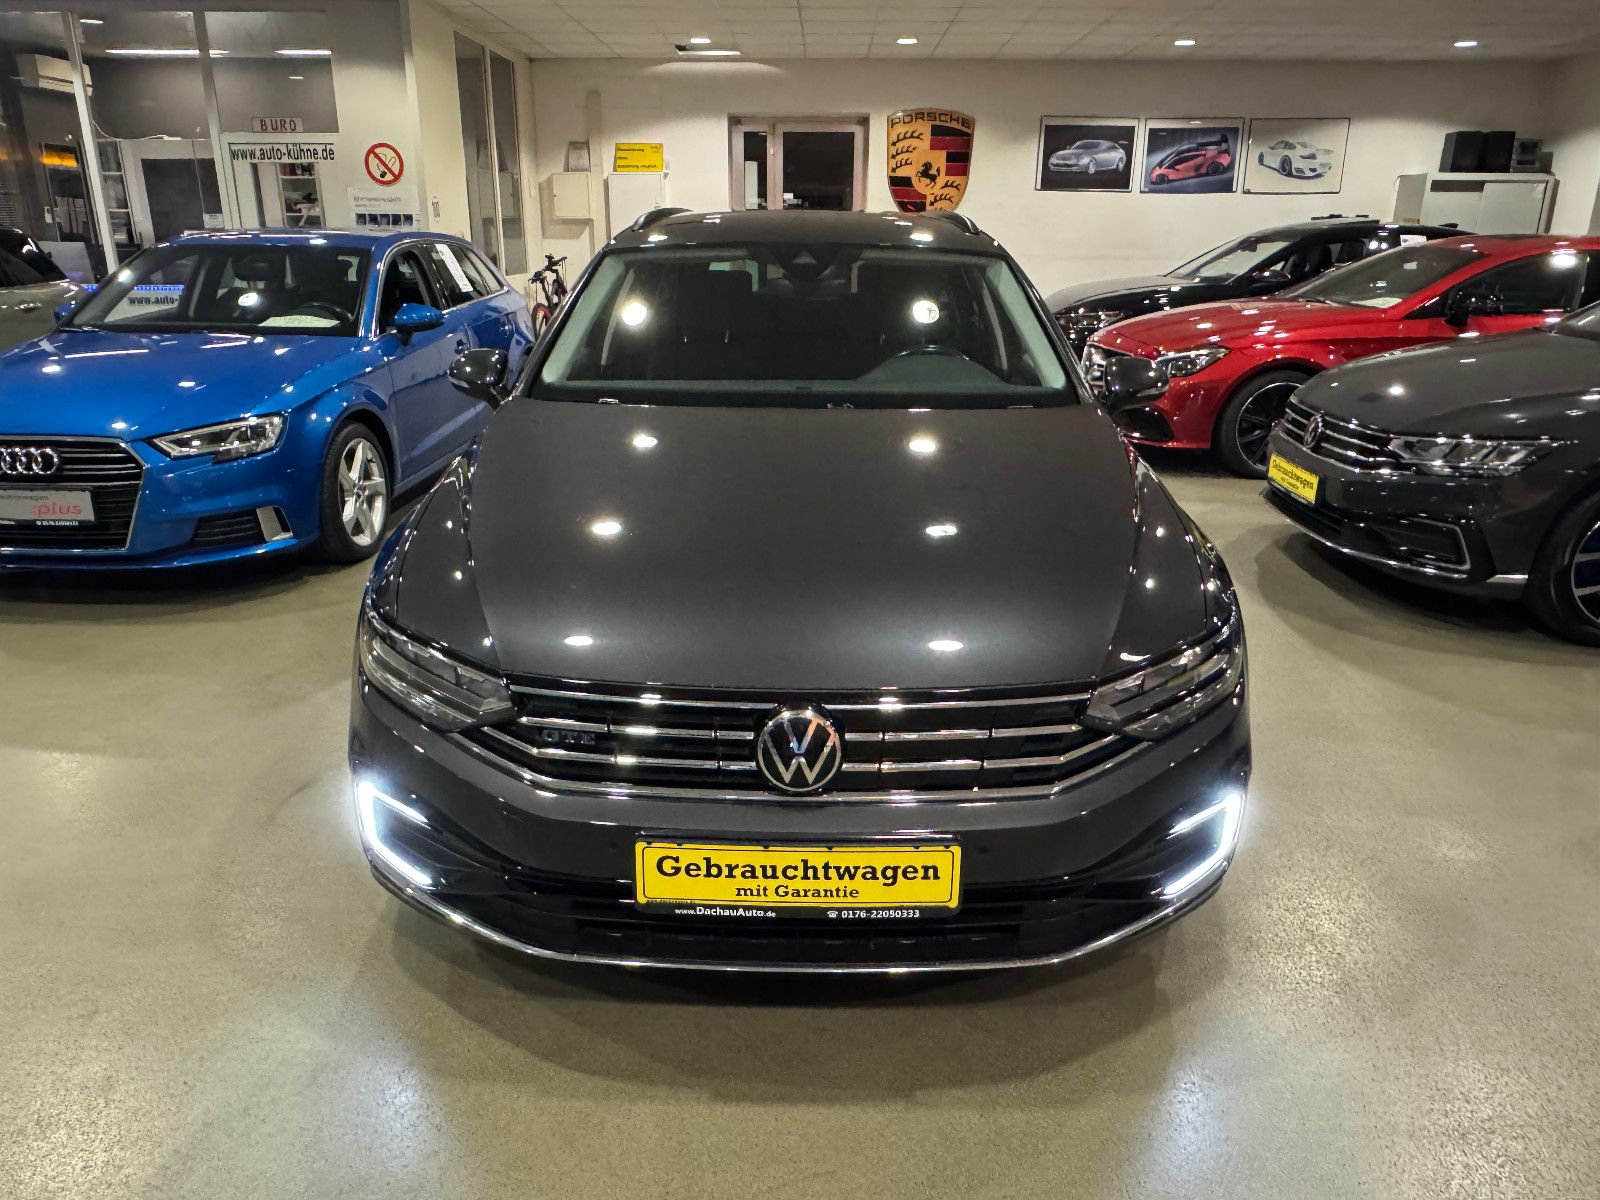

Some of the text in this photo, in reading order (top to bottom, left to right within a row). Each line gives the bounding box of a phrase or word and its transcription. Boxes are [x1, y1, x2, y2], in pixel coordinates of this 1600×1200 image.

[891, 111, 973, 131] PORSCHE
[230, 143, 335, 161] www.auto-kühne.de
[656, 855, 940, 887] Gebrauchtwagen
[735, 884, 860, 899] mit Garantie
[674, 906, 776, 918] www.DachauAuto.de
[841, 909, 920, 919] 0176-22050333
